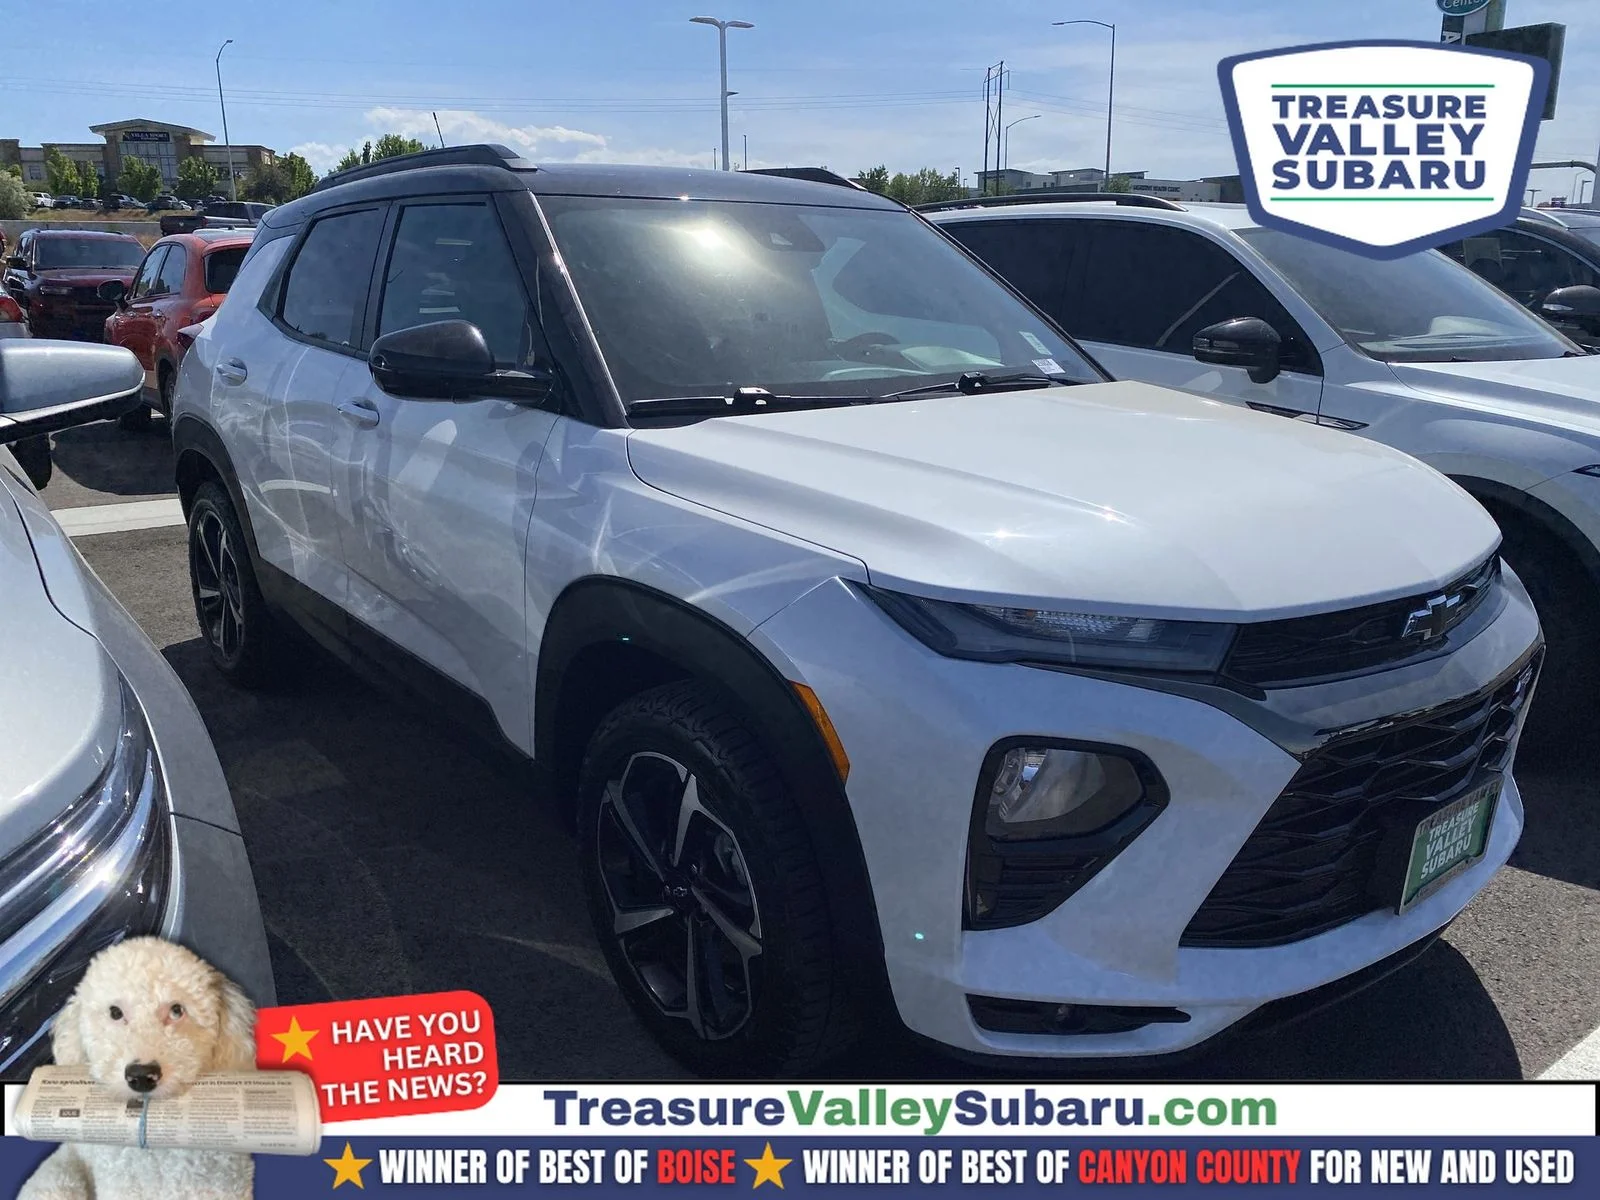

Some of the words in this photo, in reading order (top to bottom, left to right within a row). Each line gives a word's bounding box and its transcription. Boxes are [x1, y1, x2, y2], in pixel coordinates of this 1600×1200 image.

[1426, 815, 1476, 860] VALLEY
[1429, 800, 1480, 842] TREASURE
[1420, 834, 1472, 880] SUBARU
